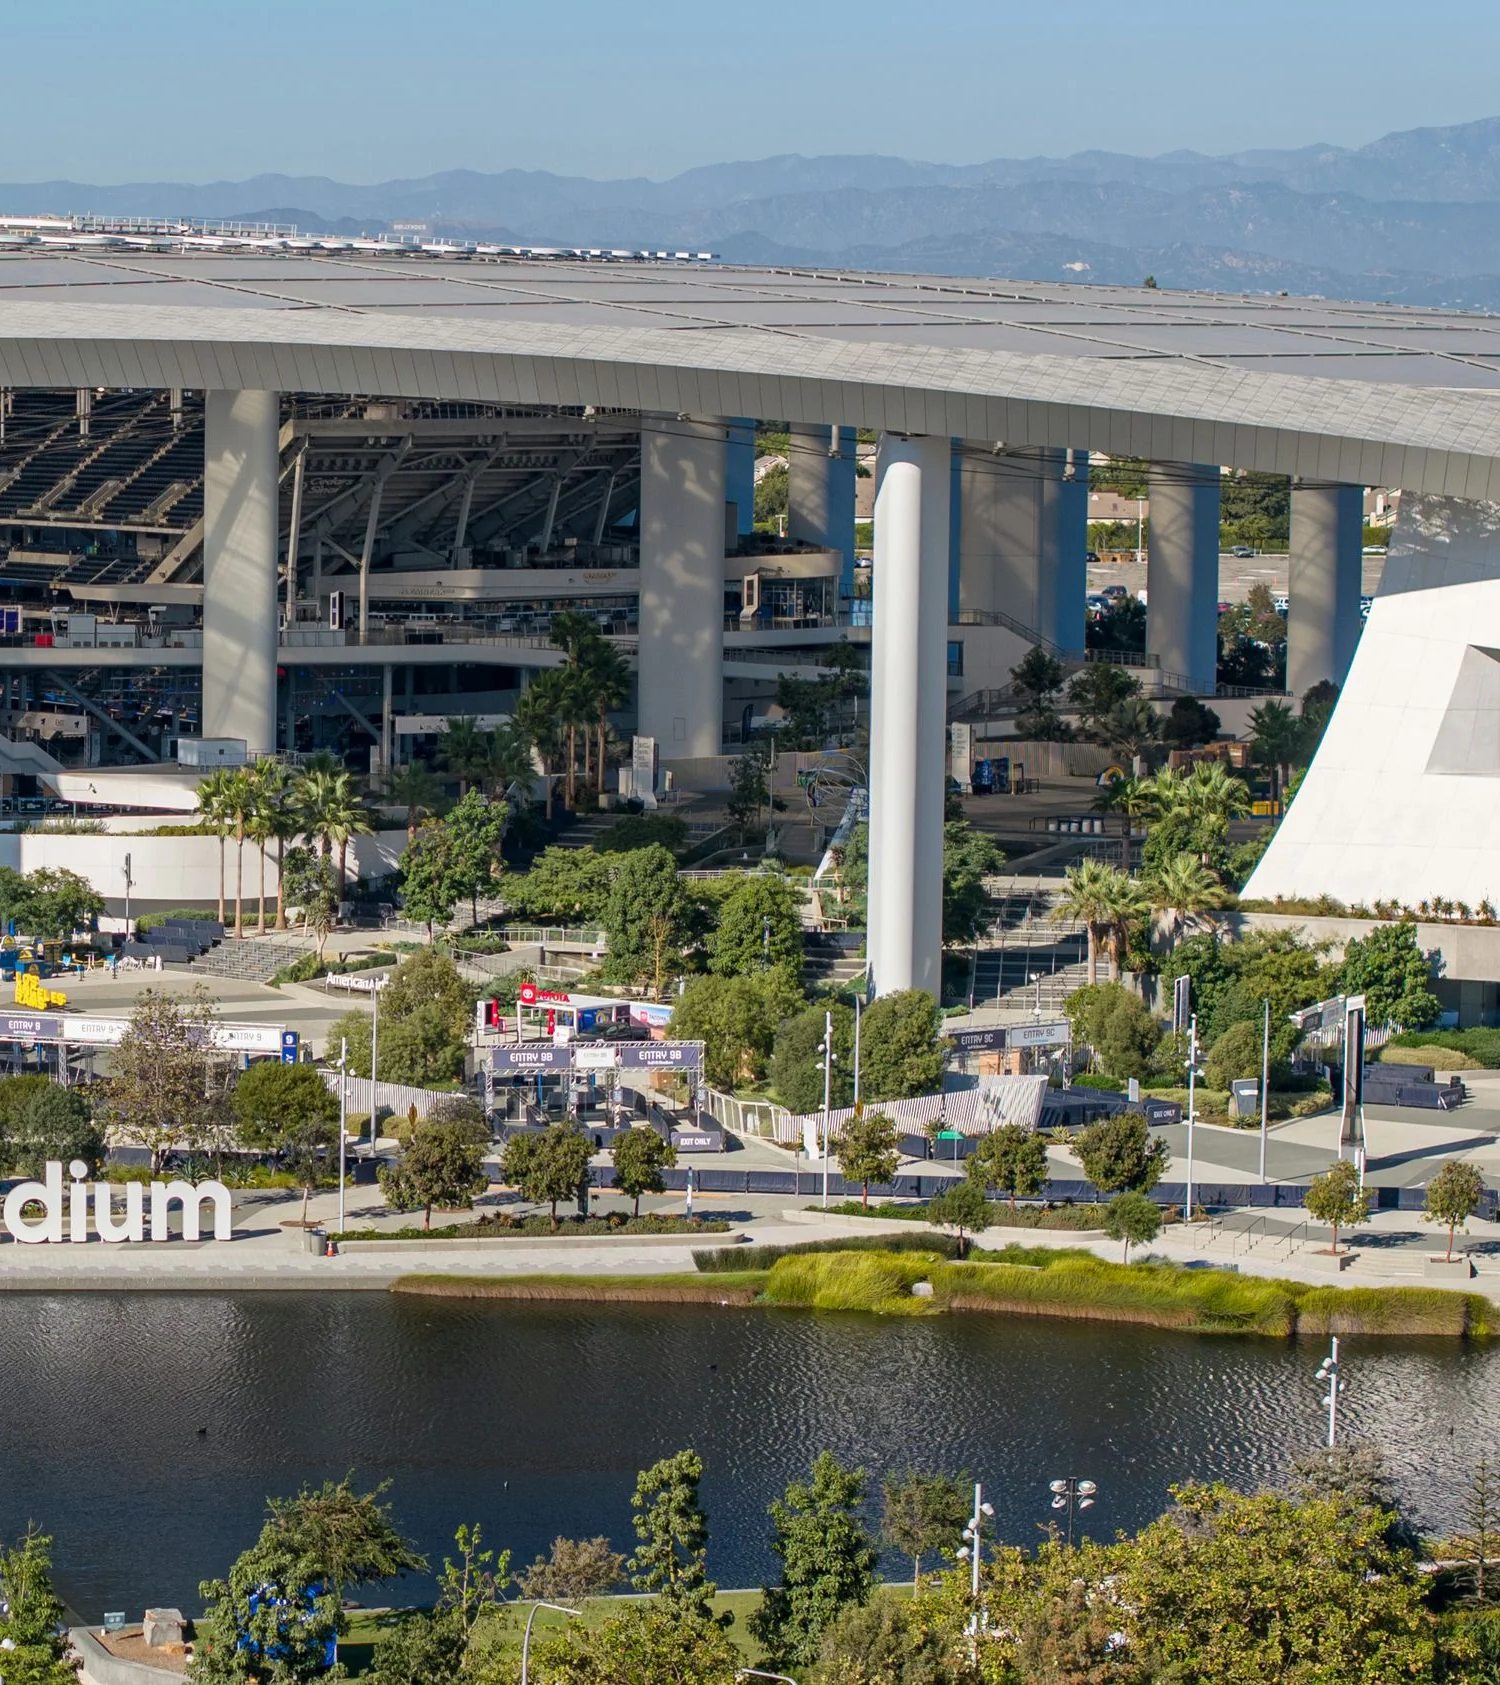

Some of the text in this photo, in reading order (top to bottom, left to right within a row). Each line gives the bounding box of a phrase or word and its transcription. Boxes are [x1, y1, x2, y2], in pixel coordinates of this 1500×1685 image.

[8, 1020, 41, 1031] ENTRY 9
[81, 1024, 106, 1033] ENTRY
[256, 1033, 262, 1042] 9
[1023, 1028, 1055, 1039] ENTRY 9C
[285, 1035, 294, 1045] 9
[961, 1033, 994, 1045] ENTRY 9C
[510, 1053, 553, 1062] ENTRY 9B
[638, 1050, 682, 1060] ENTRY 9B
[1153, 1109, 1176, 1119] EXIT ONLY
[680, 1138, 711, 1146] EXIT ONLY
